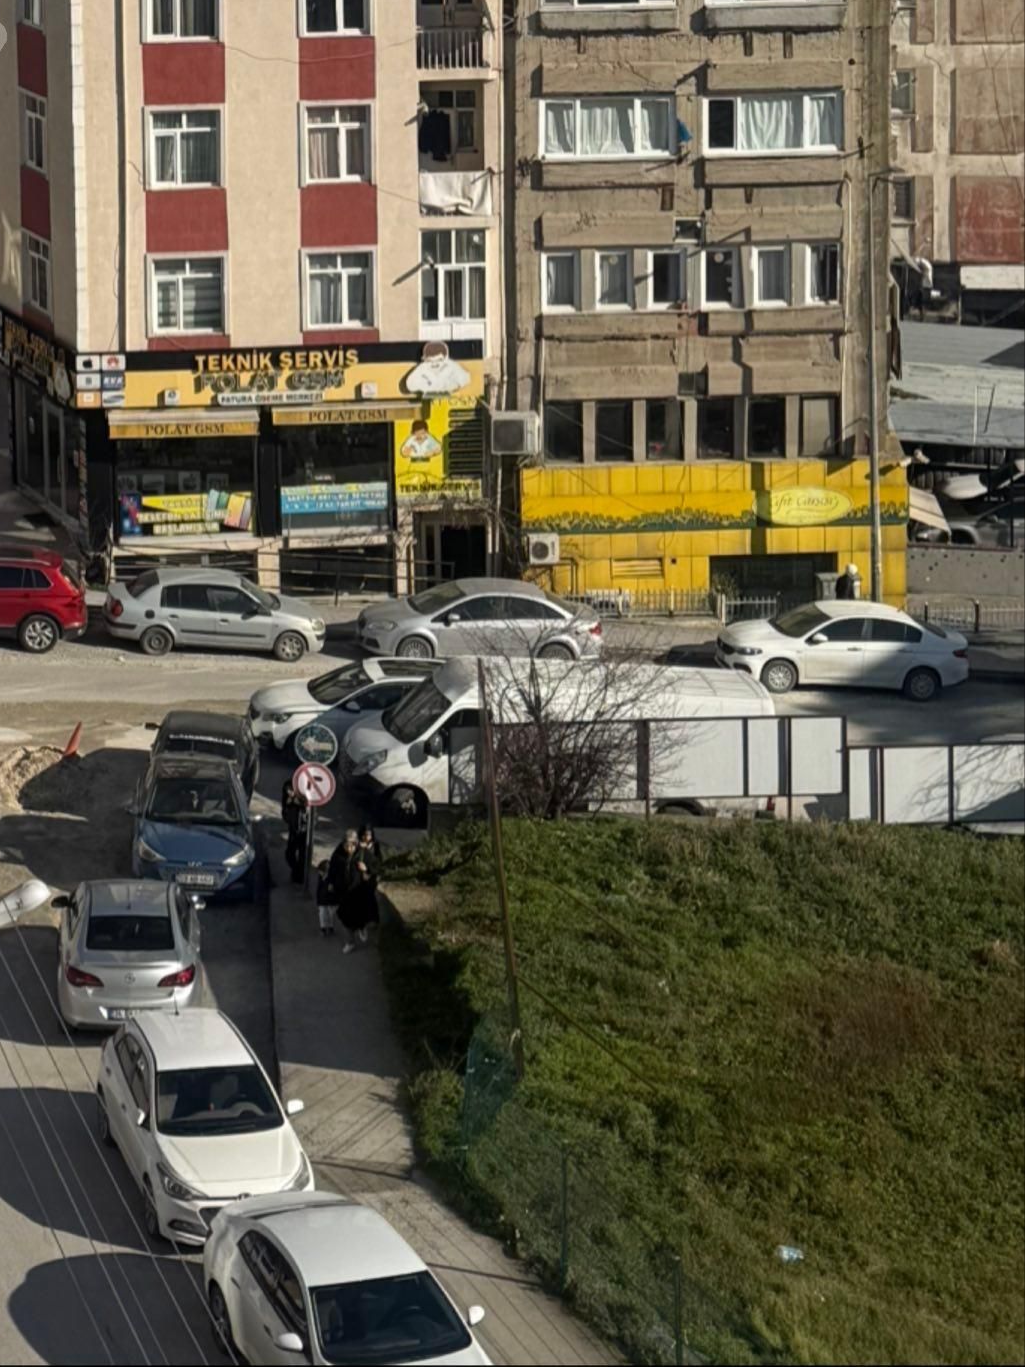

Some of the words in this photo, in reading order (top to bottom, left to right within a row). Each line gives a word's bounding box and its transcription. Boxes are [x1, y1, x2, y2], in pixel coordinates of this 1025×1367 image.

[194, 349, 273, 373] TEKNİK
[279, 345, 359, 368] SERVİS
[194, 371, 279, 393] POLAT
[286, 369, 345, 390] GSM
[309, 410, 354, 422] POLAT
[357, 408, 387, 420] GSM
[145, 423, 191, 435] POLAT
[194, 422, 224, 434] GSM
